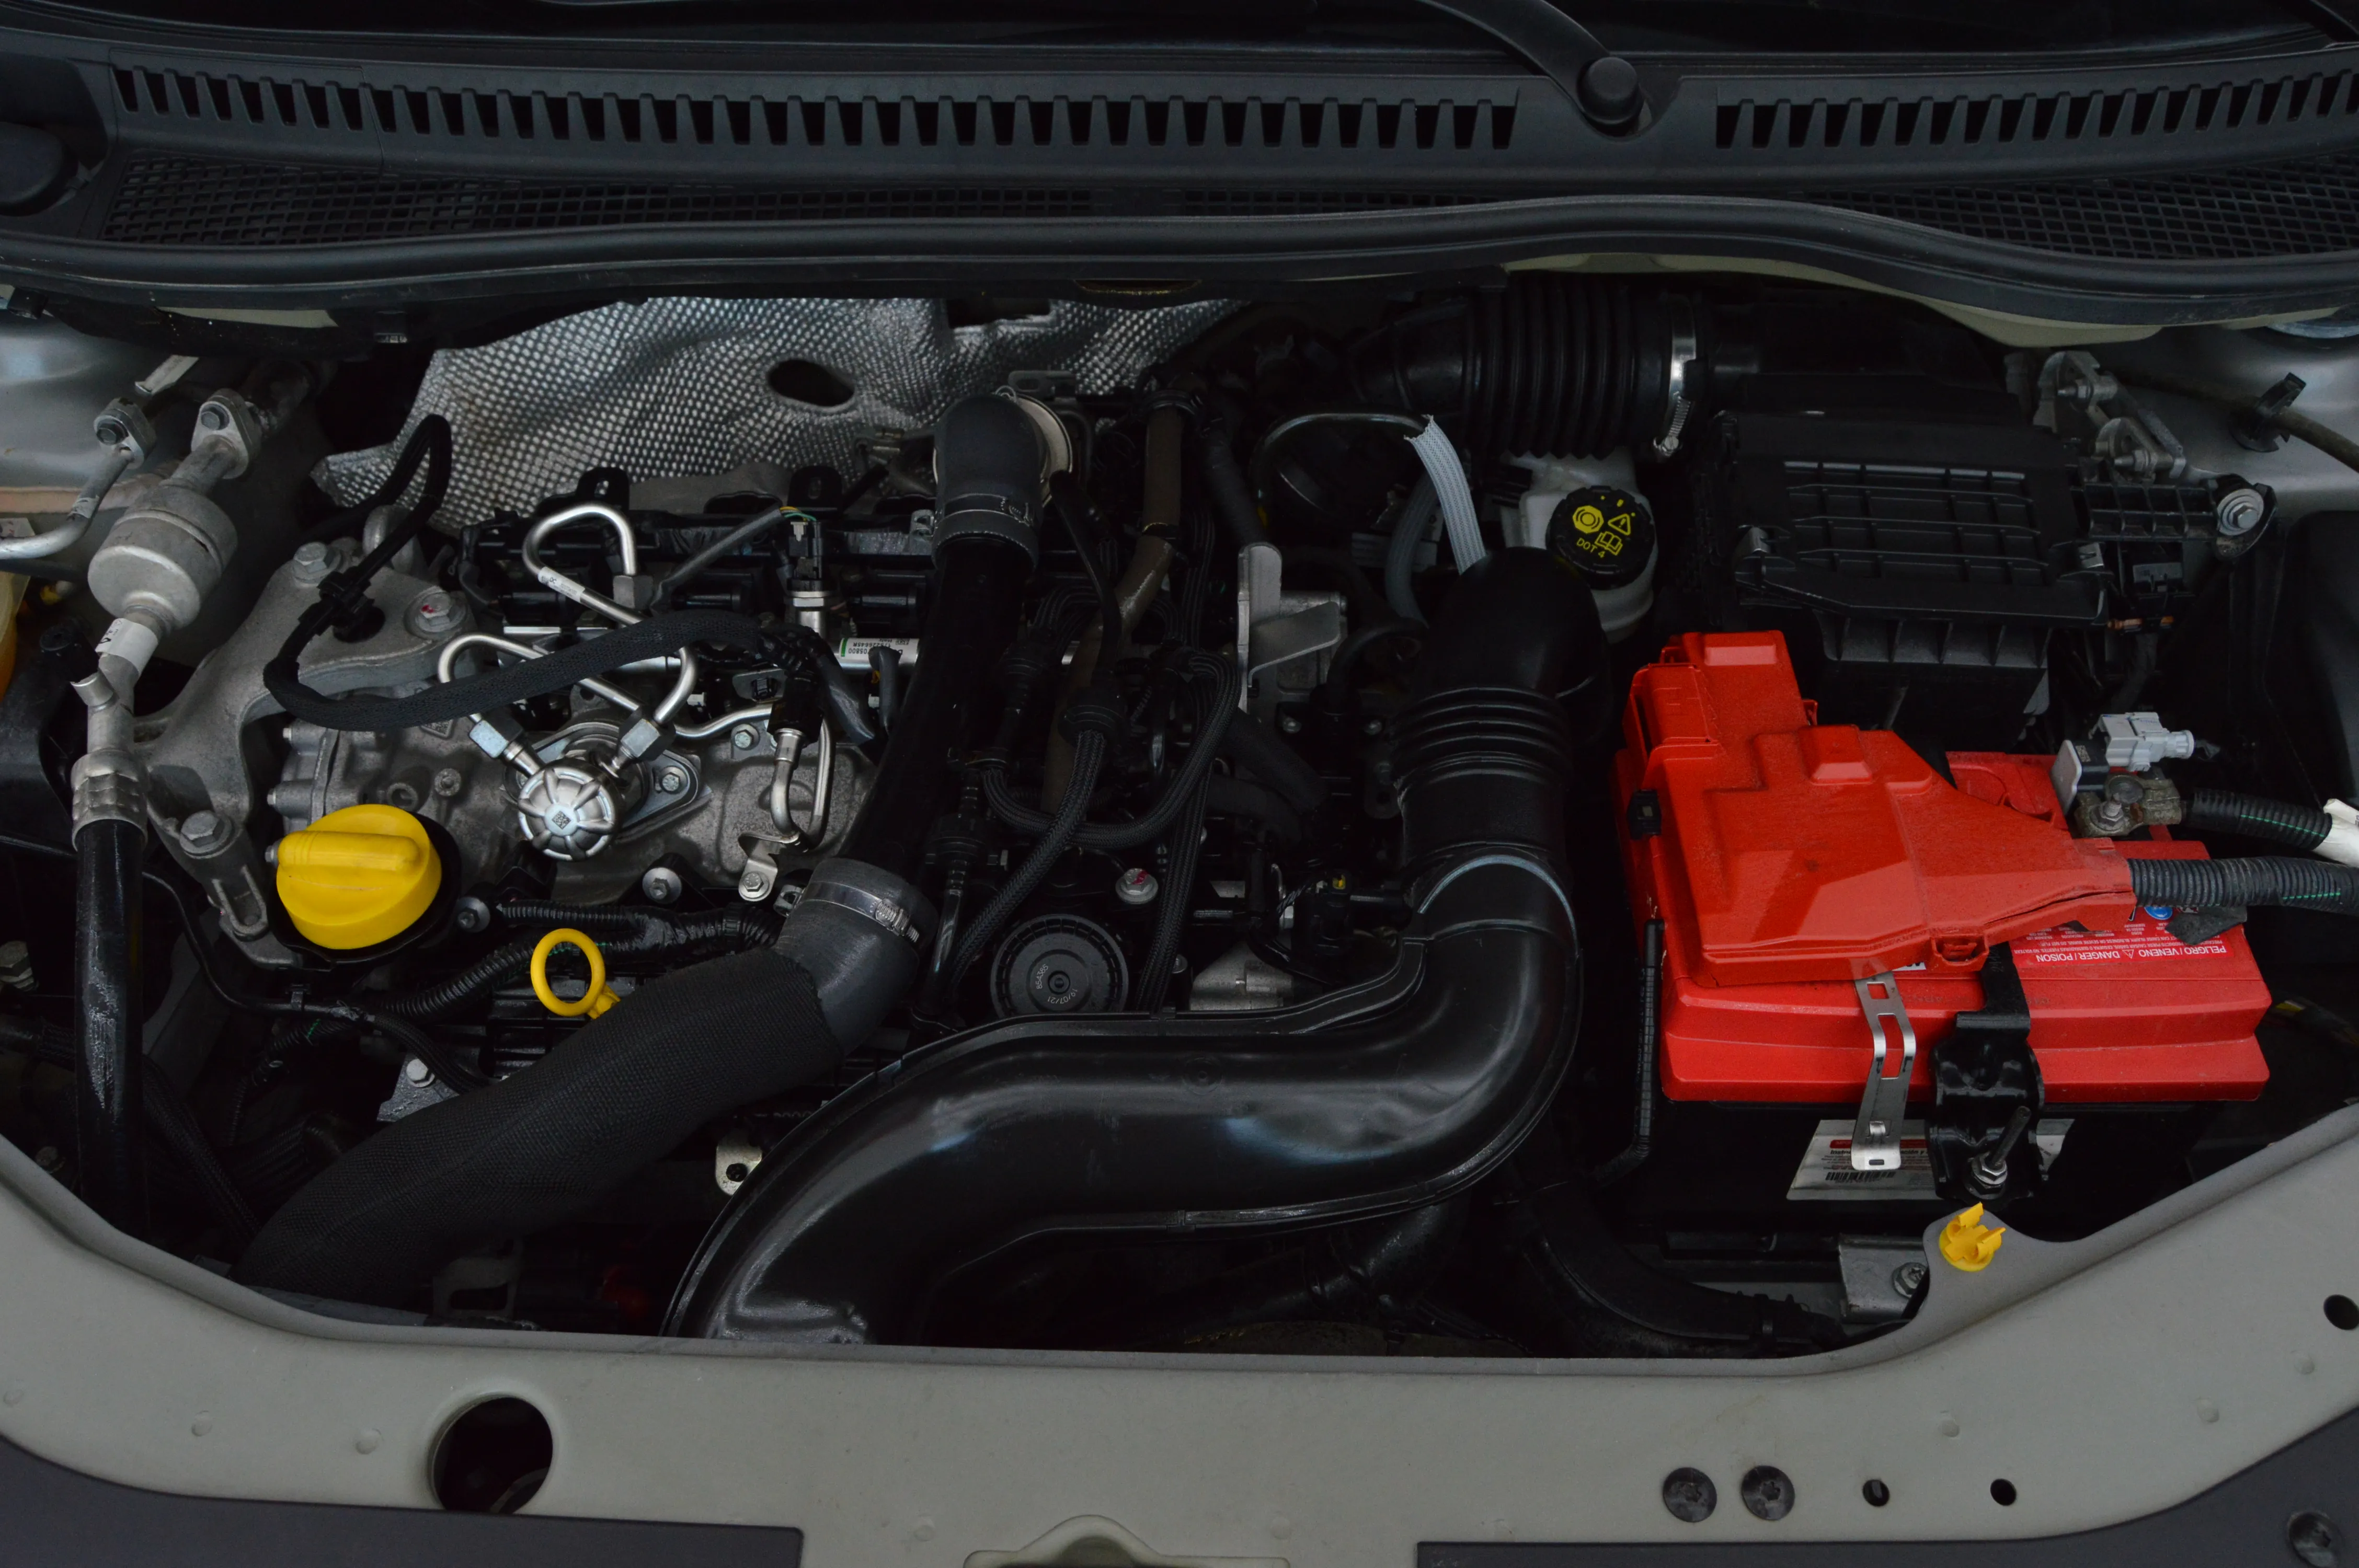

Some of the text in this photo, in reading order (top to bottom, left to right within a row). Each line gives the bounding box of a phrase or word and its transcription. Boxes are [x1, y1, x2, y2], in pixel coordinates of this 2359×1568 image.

[1576, 537, 1598, 554] DOT
[2078, 950, 2121, 960] DANGER
[2138, 947, 2179, 957] VENENO
[2184, 945, 2227, 955] PELIGRO
[2035, 952, 2073, 962] POISON
[1036, 964, 1049, 989] 854385
[1047, 988, 1078, 1004] 19/07/21
